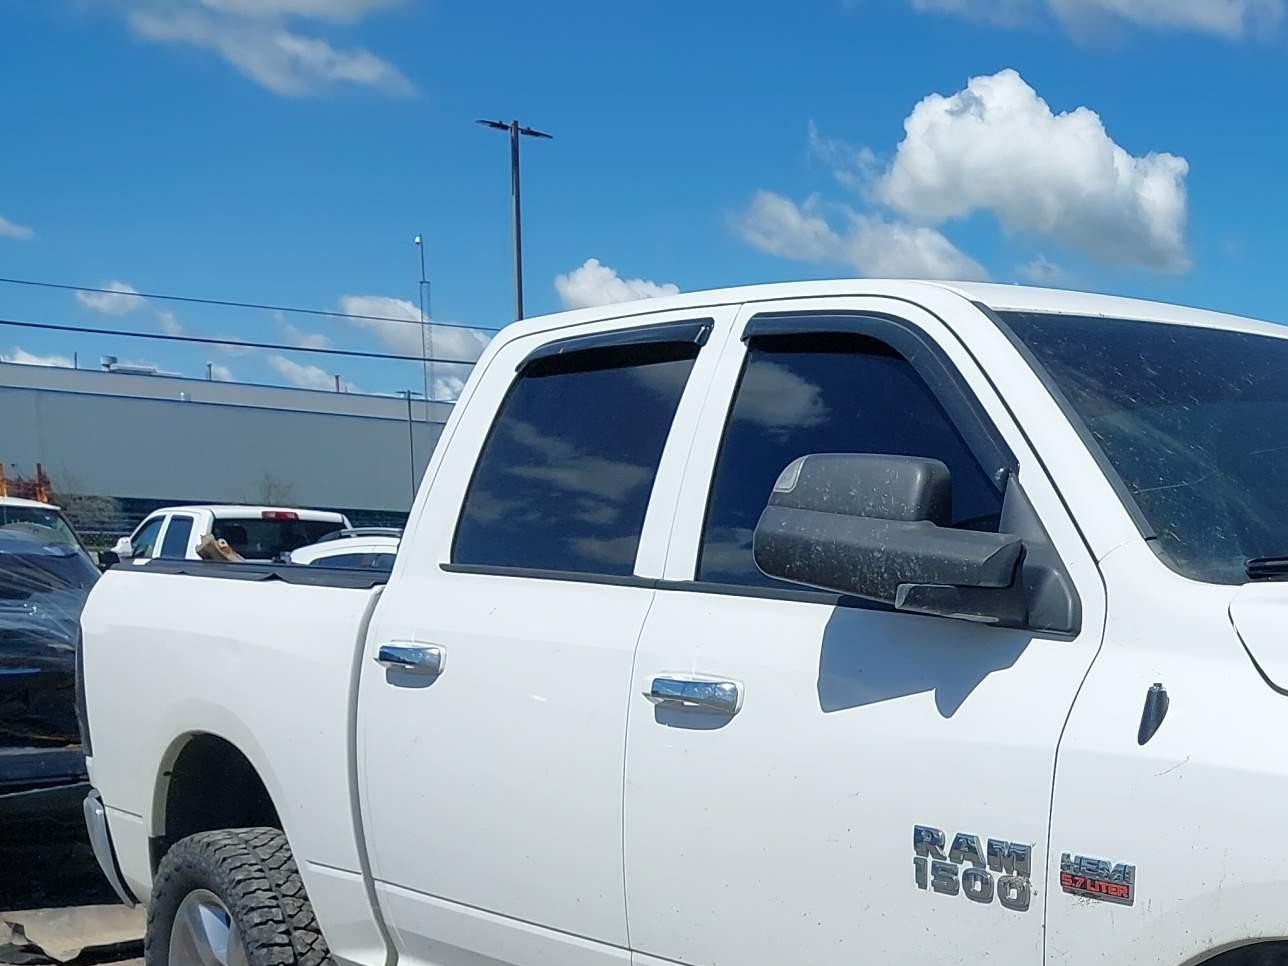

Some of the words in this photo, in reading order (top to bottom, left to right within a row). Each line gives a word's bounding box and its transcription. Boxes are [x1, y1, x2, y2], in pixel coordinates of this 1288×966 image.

[913, 825, 1032, 878] RAM
[1060, 852, 1136, 884] HEMI
[913, 857, 1032, 913] 1500
[1061, 873, 1086, 890] 5.7
[1086, 880, 1128, 898] LITER
